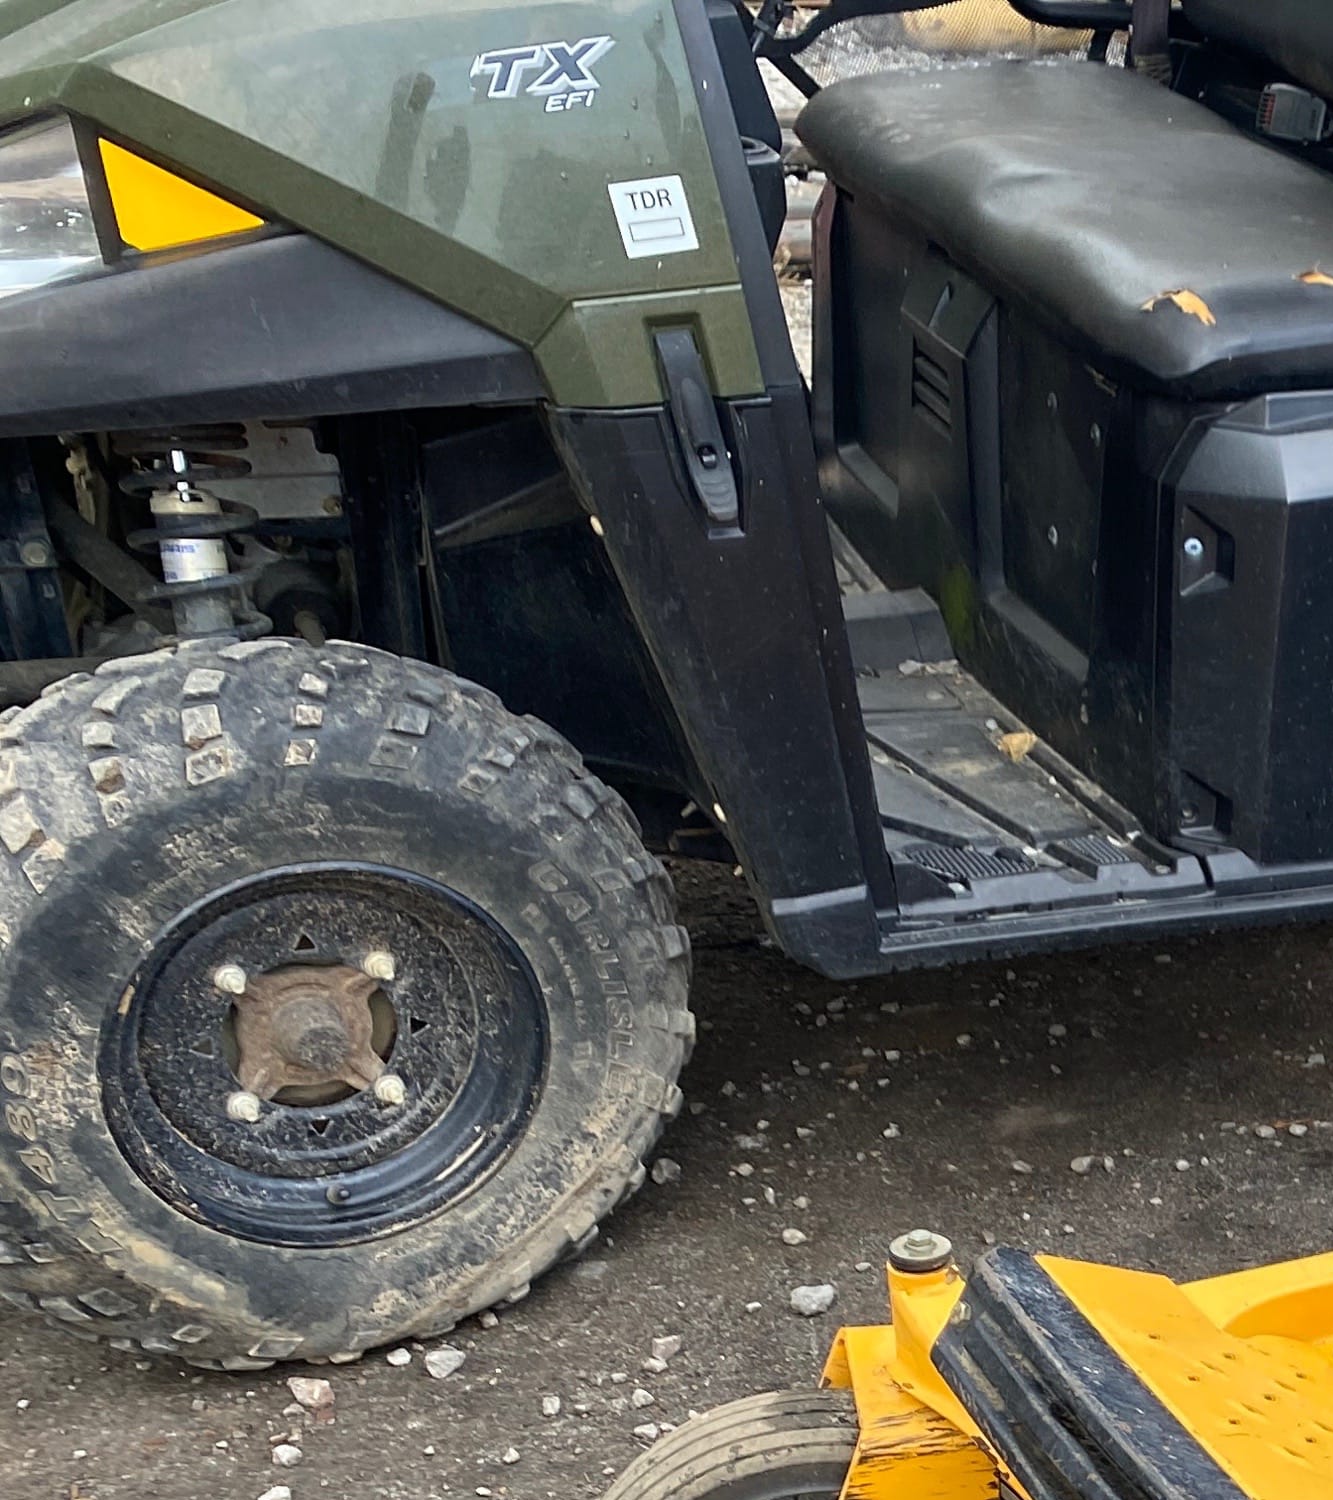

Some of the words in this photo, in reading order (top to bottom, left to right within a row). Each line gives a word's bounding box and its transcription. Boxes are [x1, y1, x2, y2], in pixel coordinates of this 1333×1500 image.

[478, 35, 616, 98] TX
[544, 89, 596, 112] EFI
[625, 189, 673, 211] TDR
[528, 859, 640, 1096] CARLISLE
